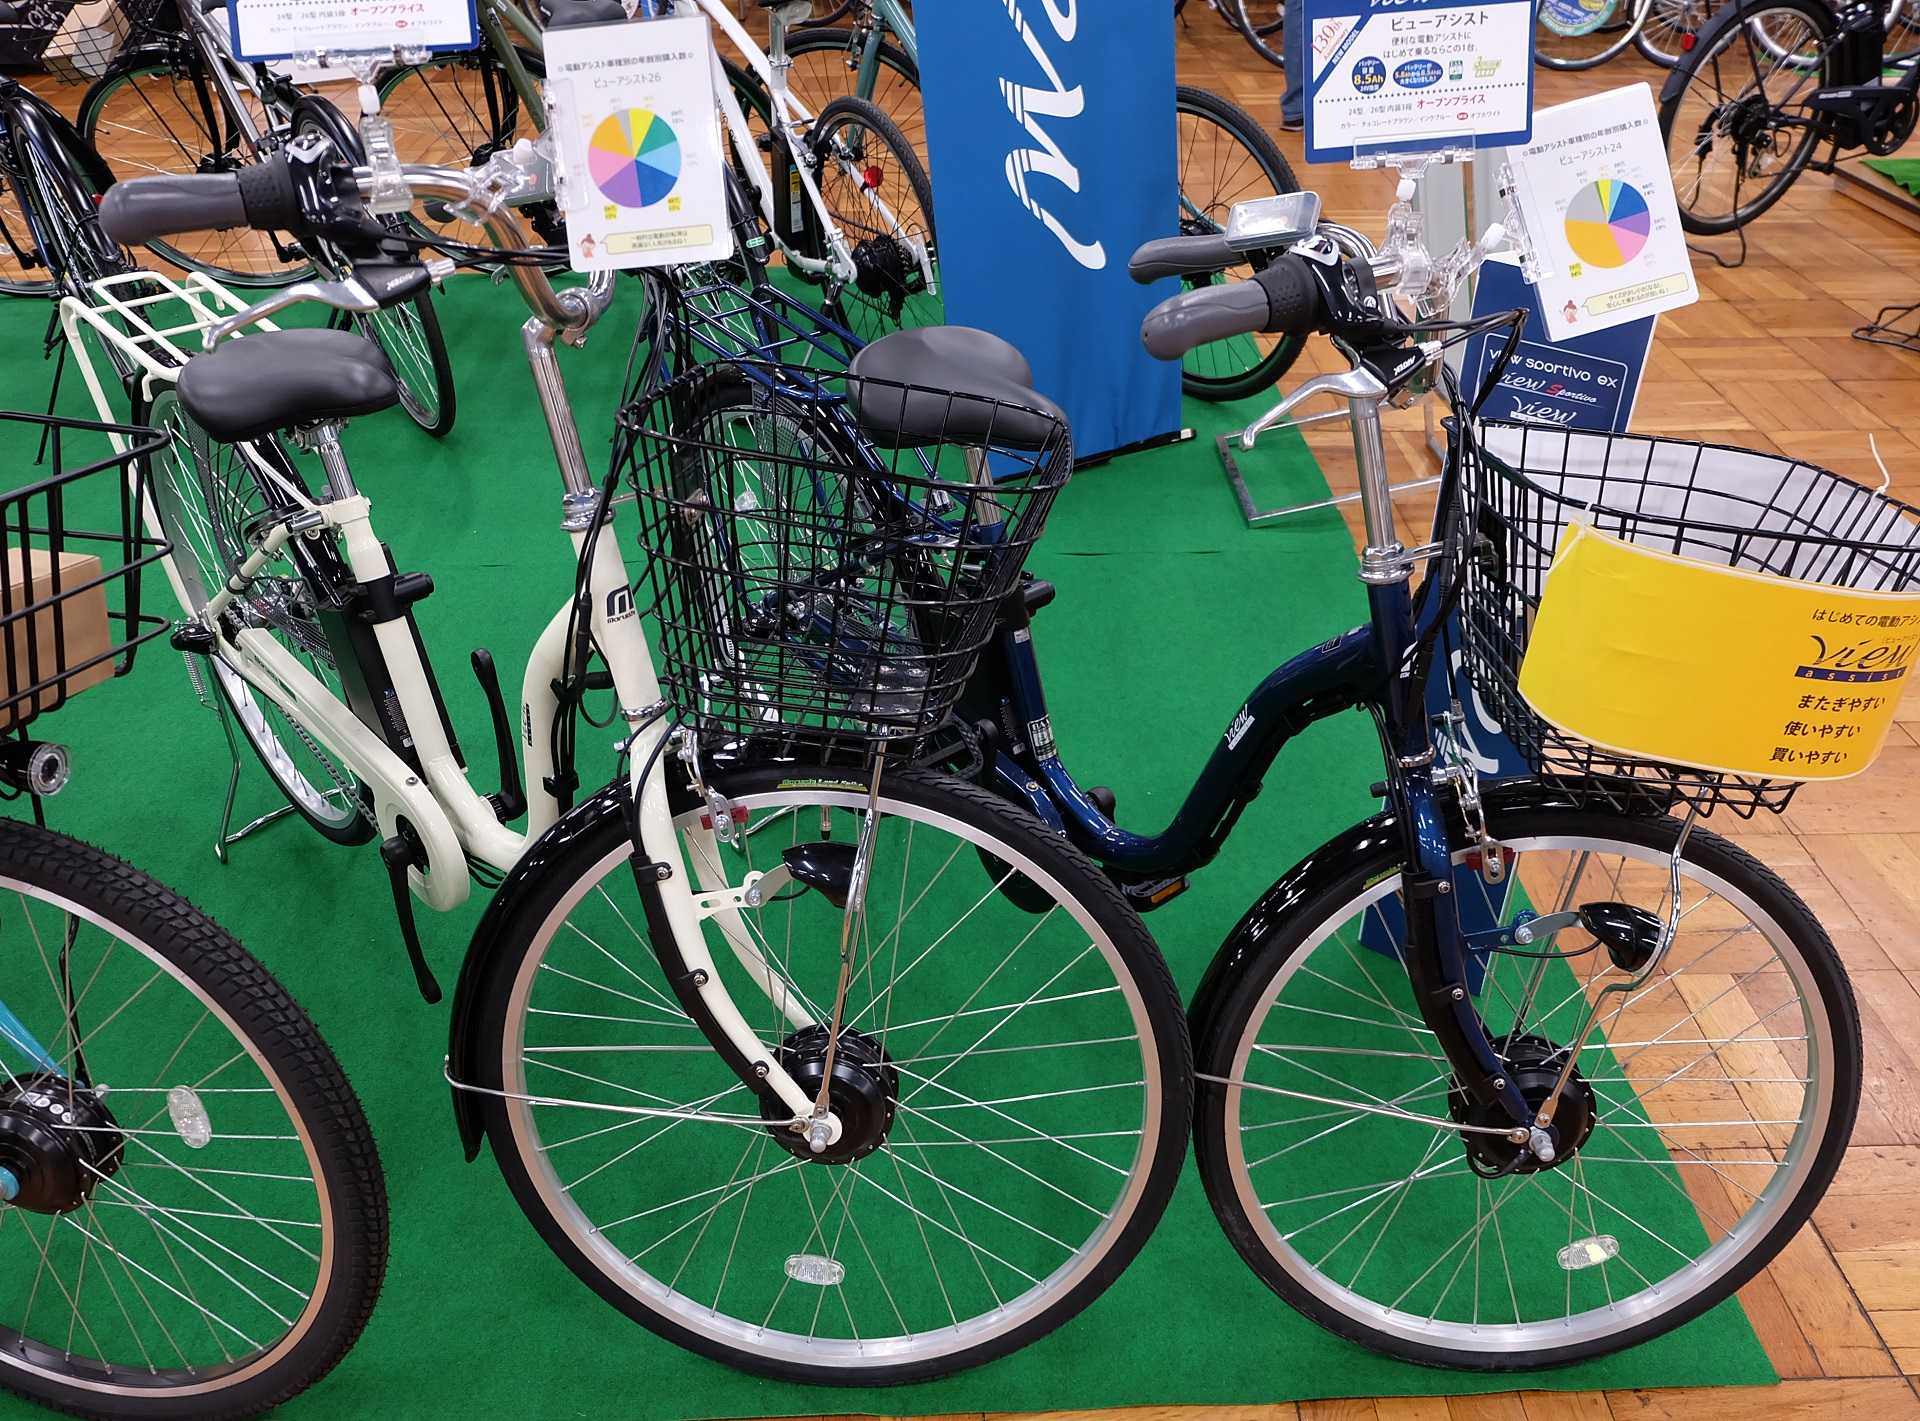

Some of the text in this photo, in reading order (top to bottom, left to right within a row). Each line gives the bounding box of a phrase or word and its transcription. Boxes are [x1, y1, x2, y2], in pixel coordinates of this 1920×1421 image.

[350, 3, 425, 17] オープンプライス
[1391, 11, 1489, 32] ビューアシスト
[1330, 29, 1360, 65] NEW MODEL
[1391, 32, 1471, 47] 便利な電動アシストに
[593, 72, 662, 89] ビューアシスト26
[1354, 74, 1384, 86] 8.5Ah
[1416, 94, 1486, 109] オープンプライス
[1559, 142, 1622, 166] ビューアシスト24
[1489, 349, 1523, 365] viw
[1597, 374, 1619, 389] ex
[1545, 383, 1598, 404] Sportivo
[1811, 608, 1920, 628] はじめての電動アシ
[1804, 667, 1903, 683] assist
[1797, 694, 1886, 713] またぎやすい
[1783, 720, 1861, 739] 使いやすい
[1768, 746, 1848, 765] 買いやすい
